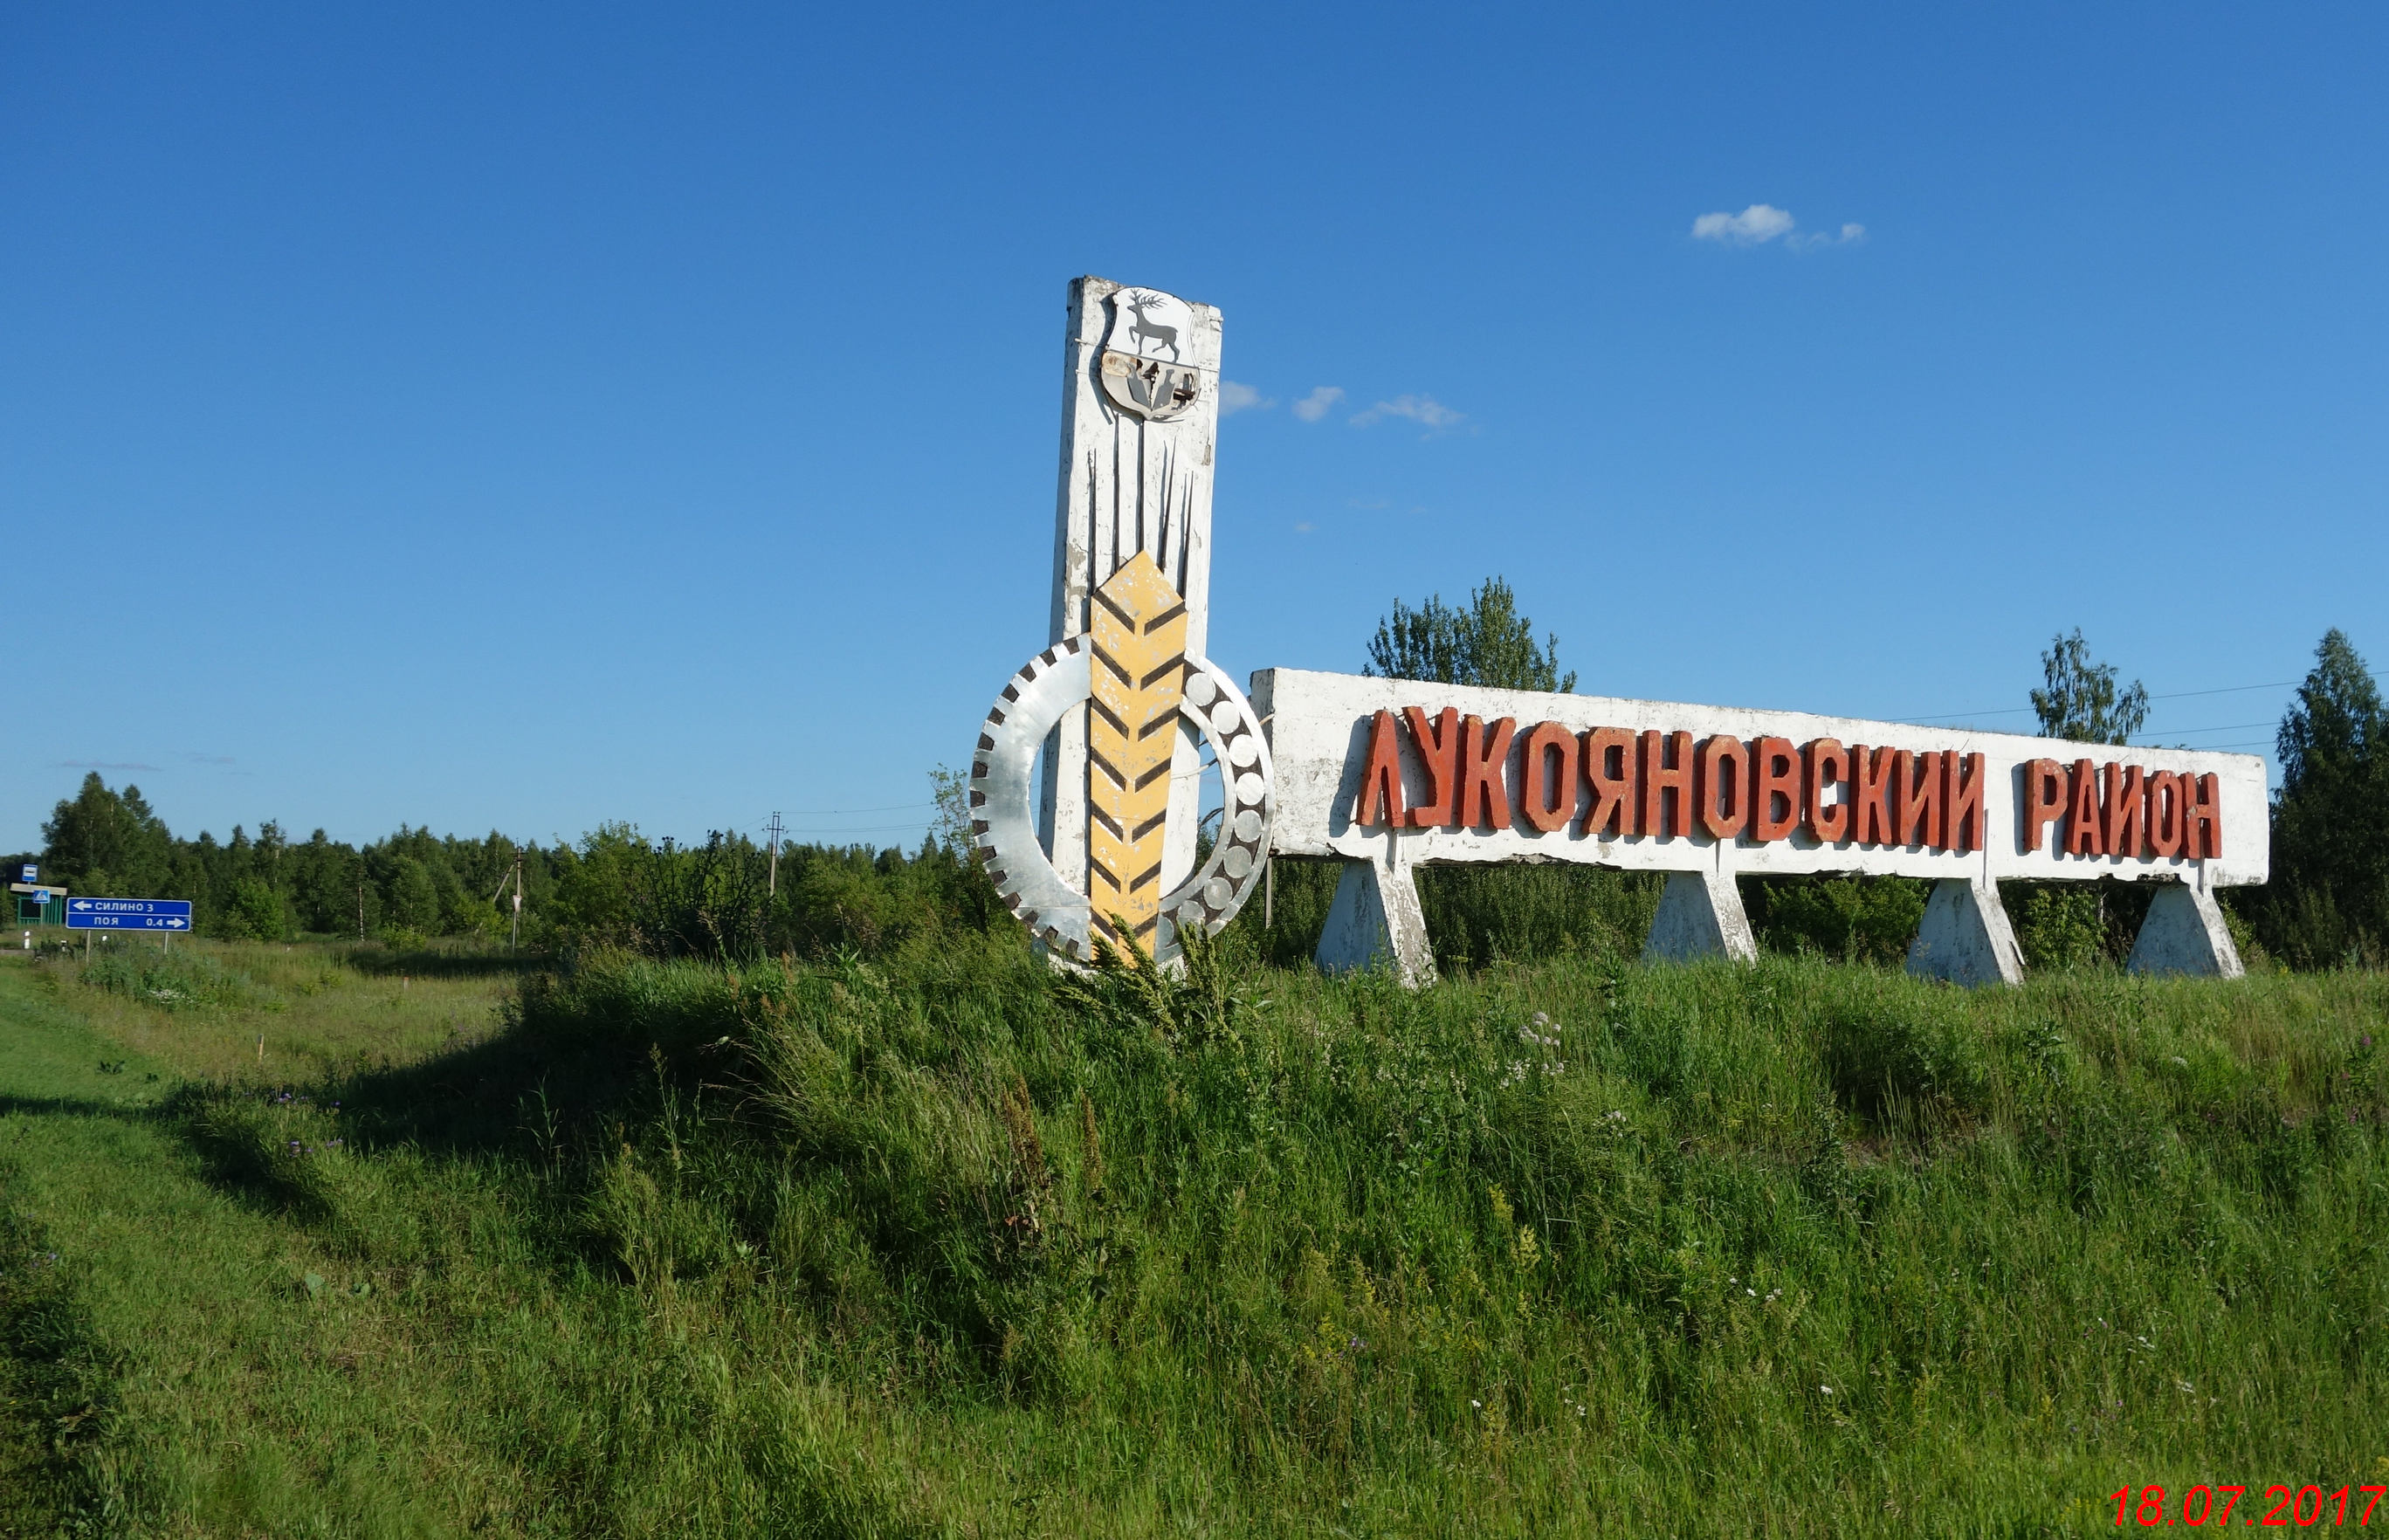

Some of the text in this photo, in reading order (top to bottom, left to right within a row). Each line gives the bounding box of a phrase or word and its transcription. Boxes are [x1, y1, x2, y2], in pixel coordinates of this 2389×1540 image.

[94, 902, 154, 912] СИЛИНО 3
[93, 917, 163, 926] ПОЯ 0.4
